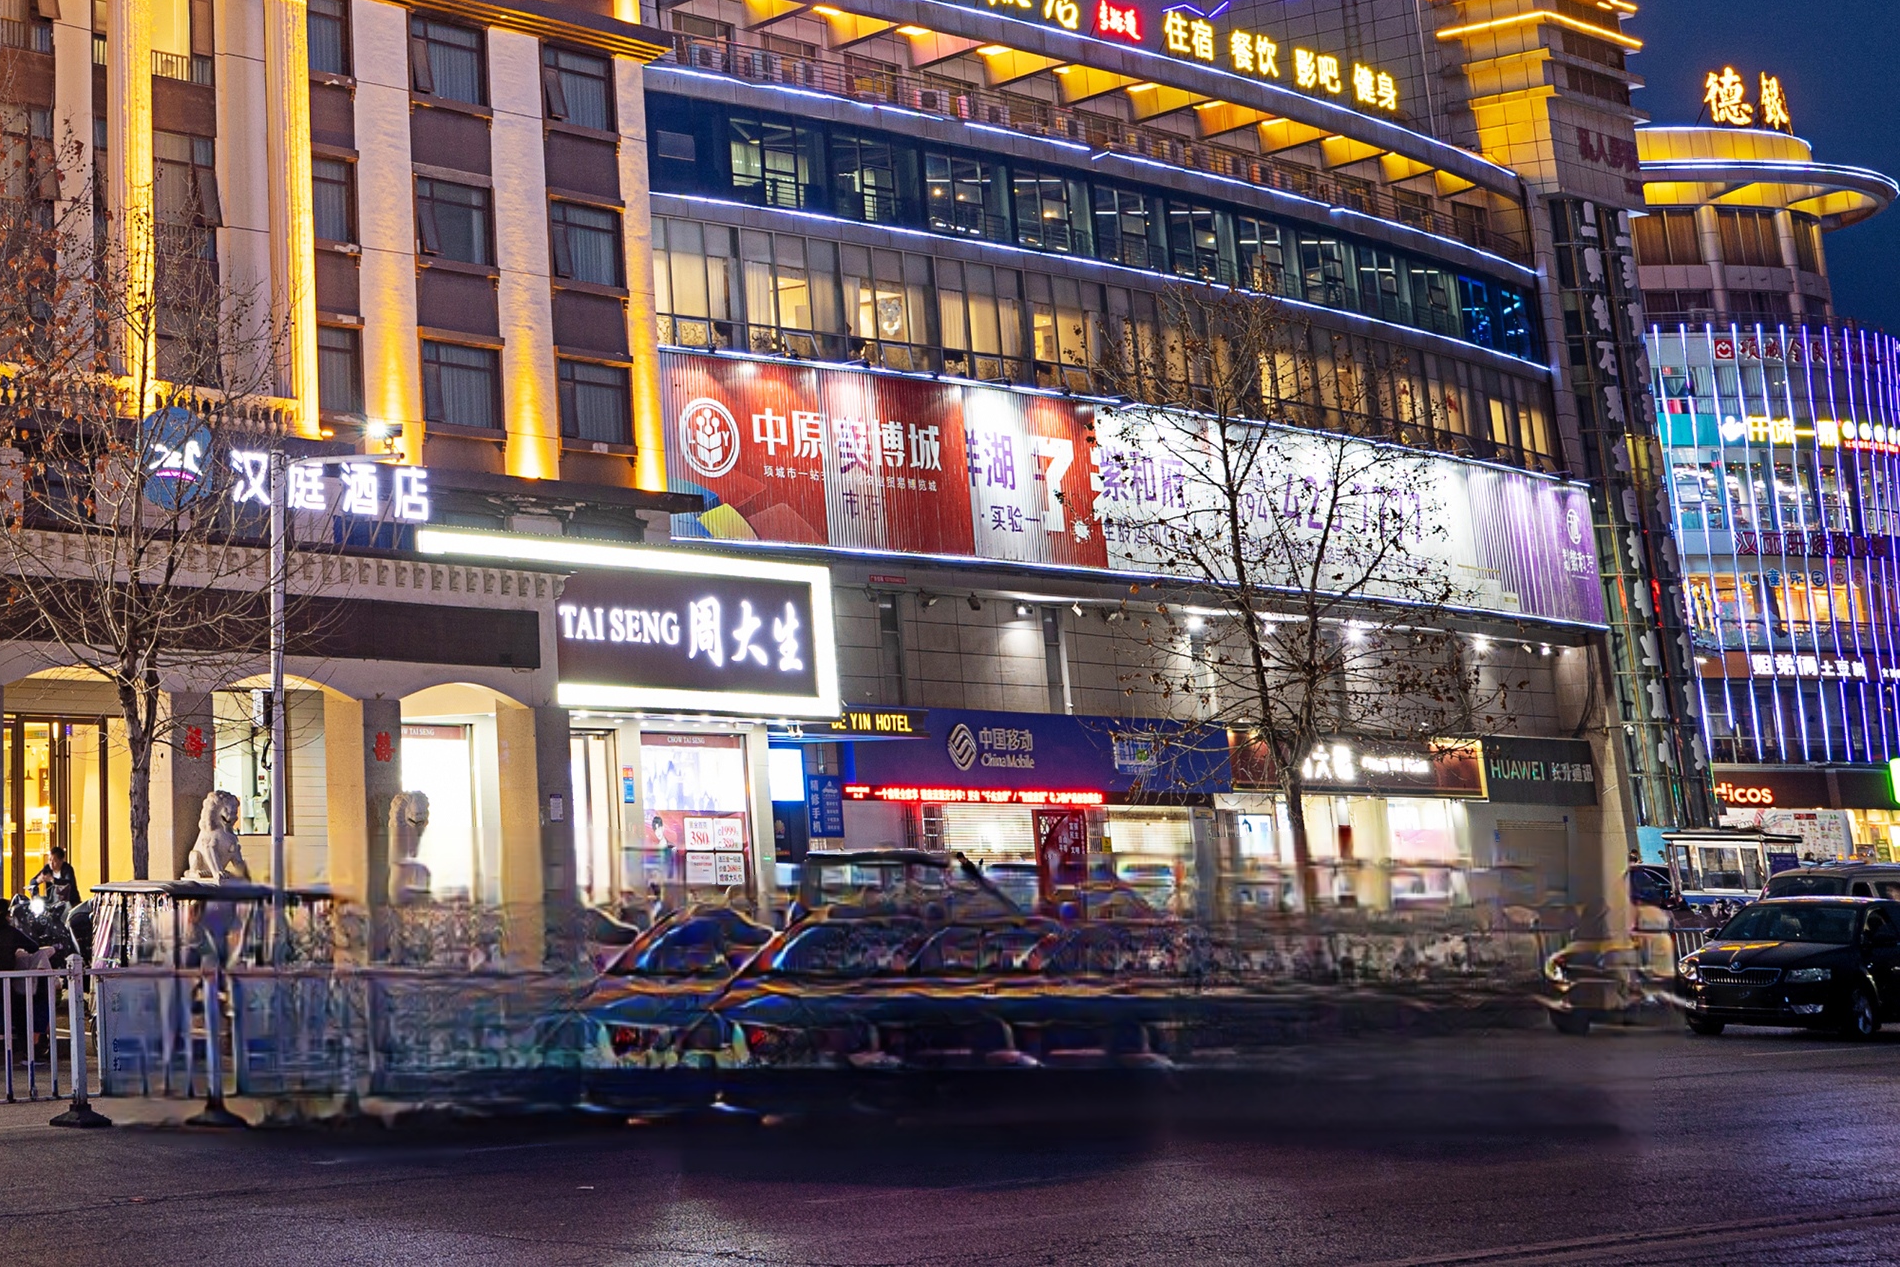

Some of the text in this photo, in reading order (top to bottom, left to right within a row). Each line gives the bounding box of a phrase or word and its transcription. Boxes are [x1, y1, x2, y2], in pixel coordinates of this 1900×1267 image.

[1164, 10, 1397, 110] 住宿 餐饮 影吧 健身
[230, 449, 430, 521] 汉庭酒店
[1099, 445, 1186, 509] 紫和府
[1222, 491, 1268, 523] 394
[558, 604, 680, 646] TAI SENG
[688, 595, 804, 672] 周大生
[849, 712, 871, 730] YIN
[875, 713, 913, 732] HOTEL
[978, 726, 1034, 752] 中国移动
[980, 752, 1036, 770] China Mobile
[1490, 759, 1546, 781] HUAWEI
